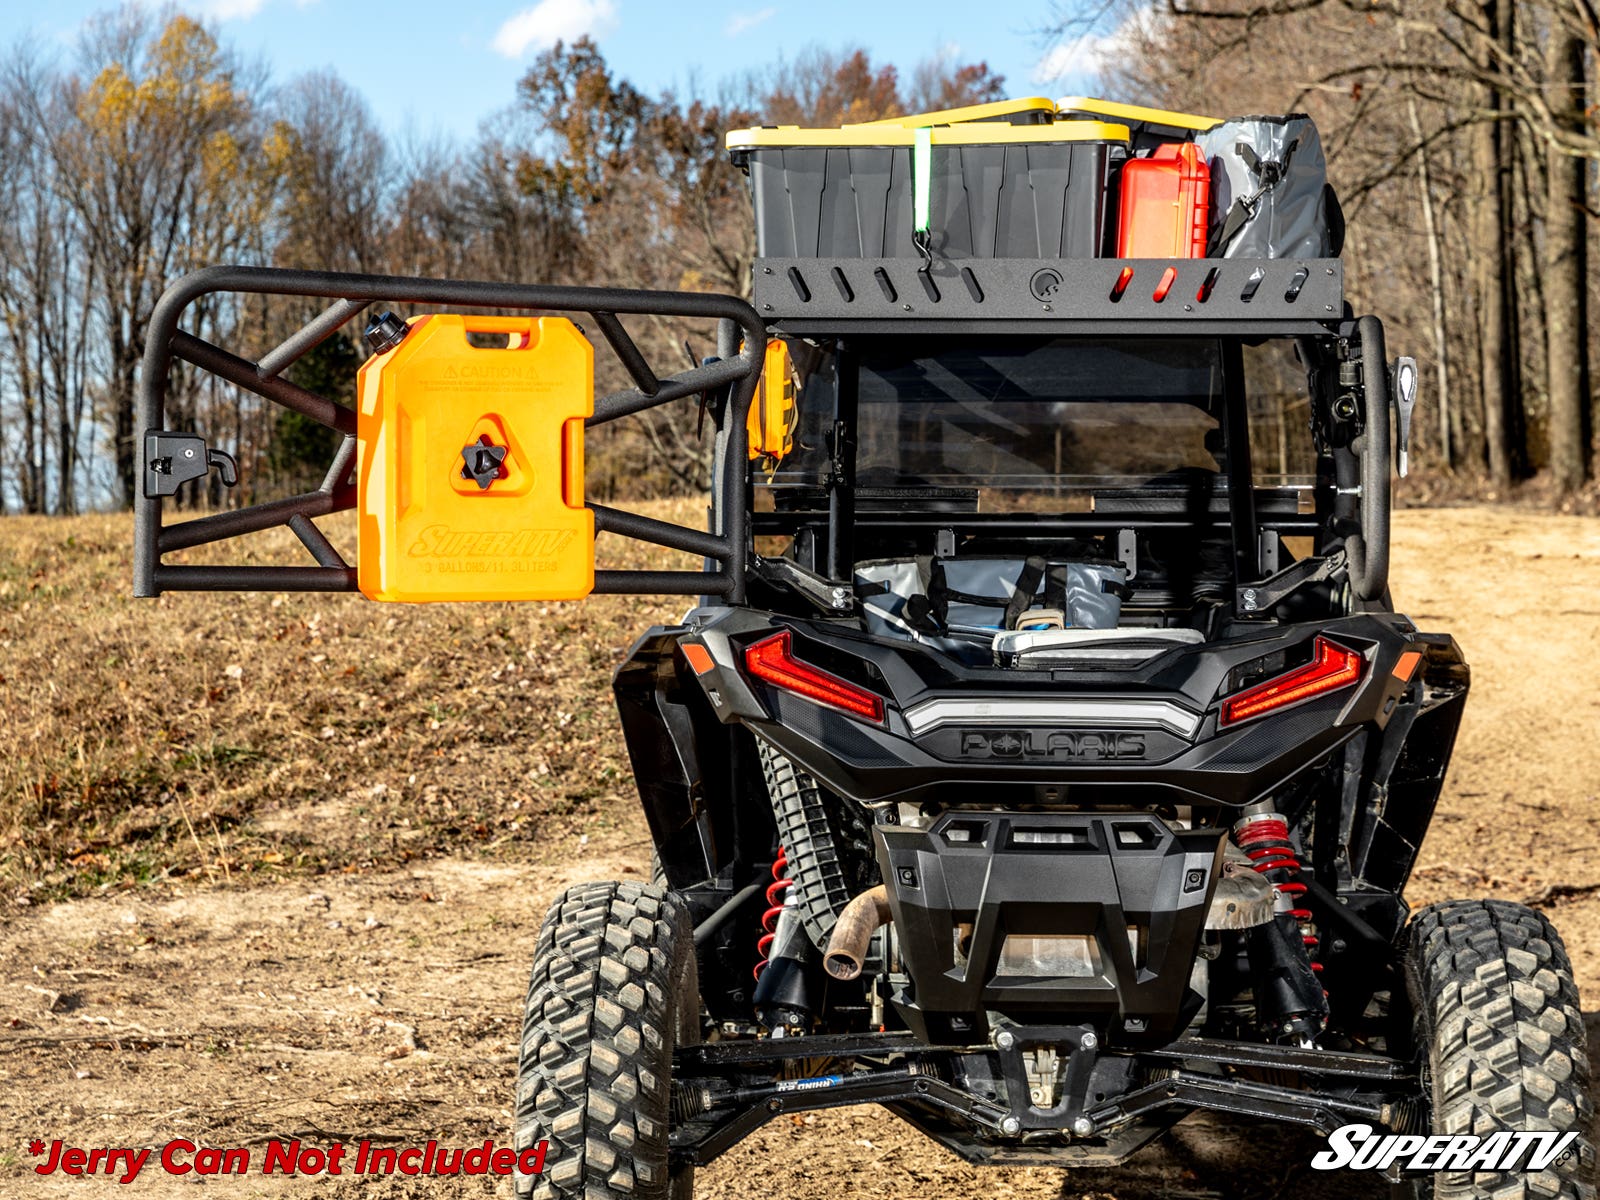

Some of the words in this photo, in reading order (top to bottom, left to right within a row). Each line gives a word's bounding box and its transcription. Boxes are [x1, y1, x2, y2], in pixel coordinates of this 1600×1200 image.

[460, 366, 521, 378] CAUTION
[962, 732, 1147, 758] POLARIS
[797, 1079, 831, 1090] RHINO
